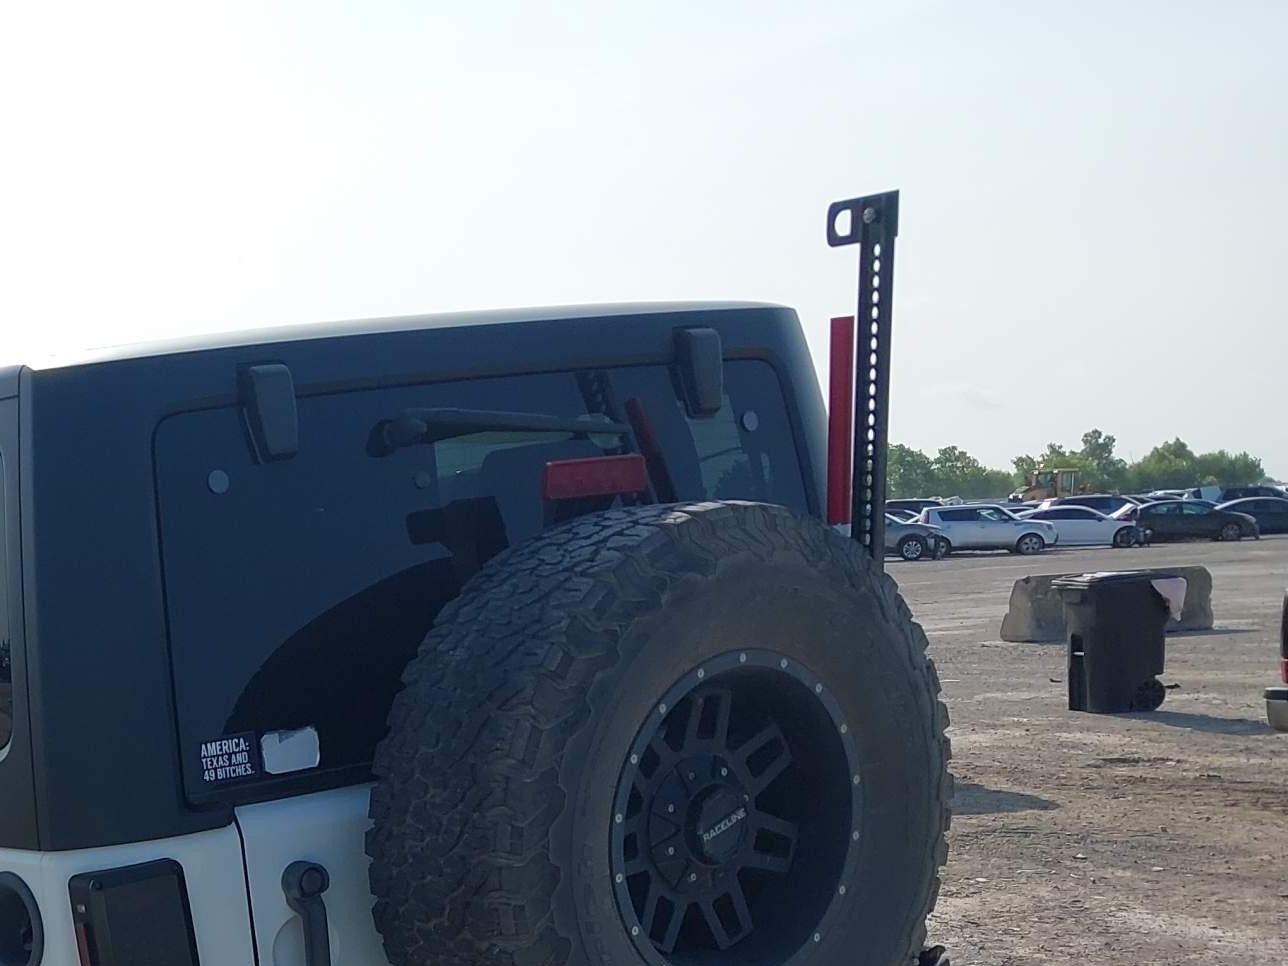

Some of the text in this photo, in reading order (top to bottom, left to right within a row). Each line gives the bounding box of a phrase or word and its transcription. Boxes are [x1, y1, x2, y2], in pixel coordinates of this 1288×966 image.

[200, 737, 250, 758] AMERICA:
[201, 751, 249, 770] TEXAS AND
[203, 768, 216, 782] 49
[703, 808, 746, 842] RACELINE
